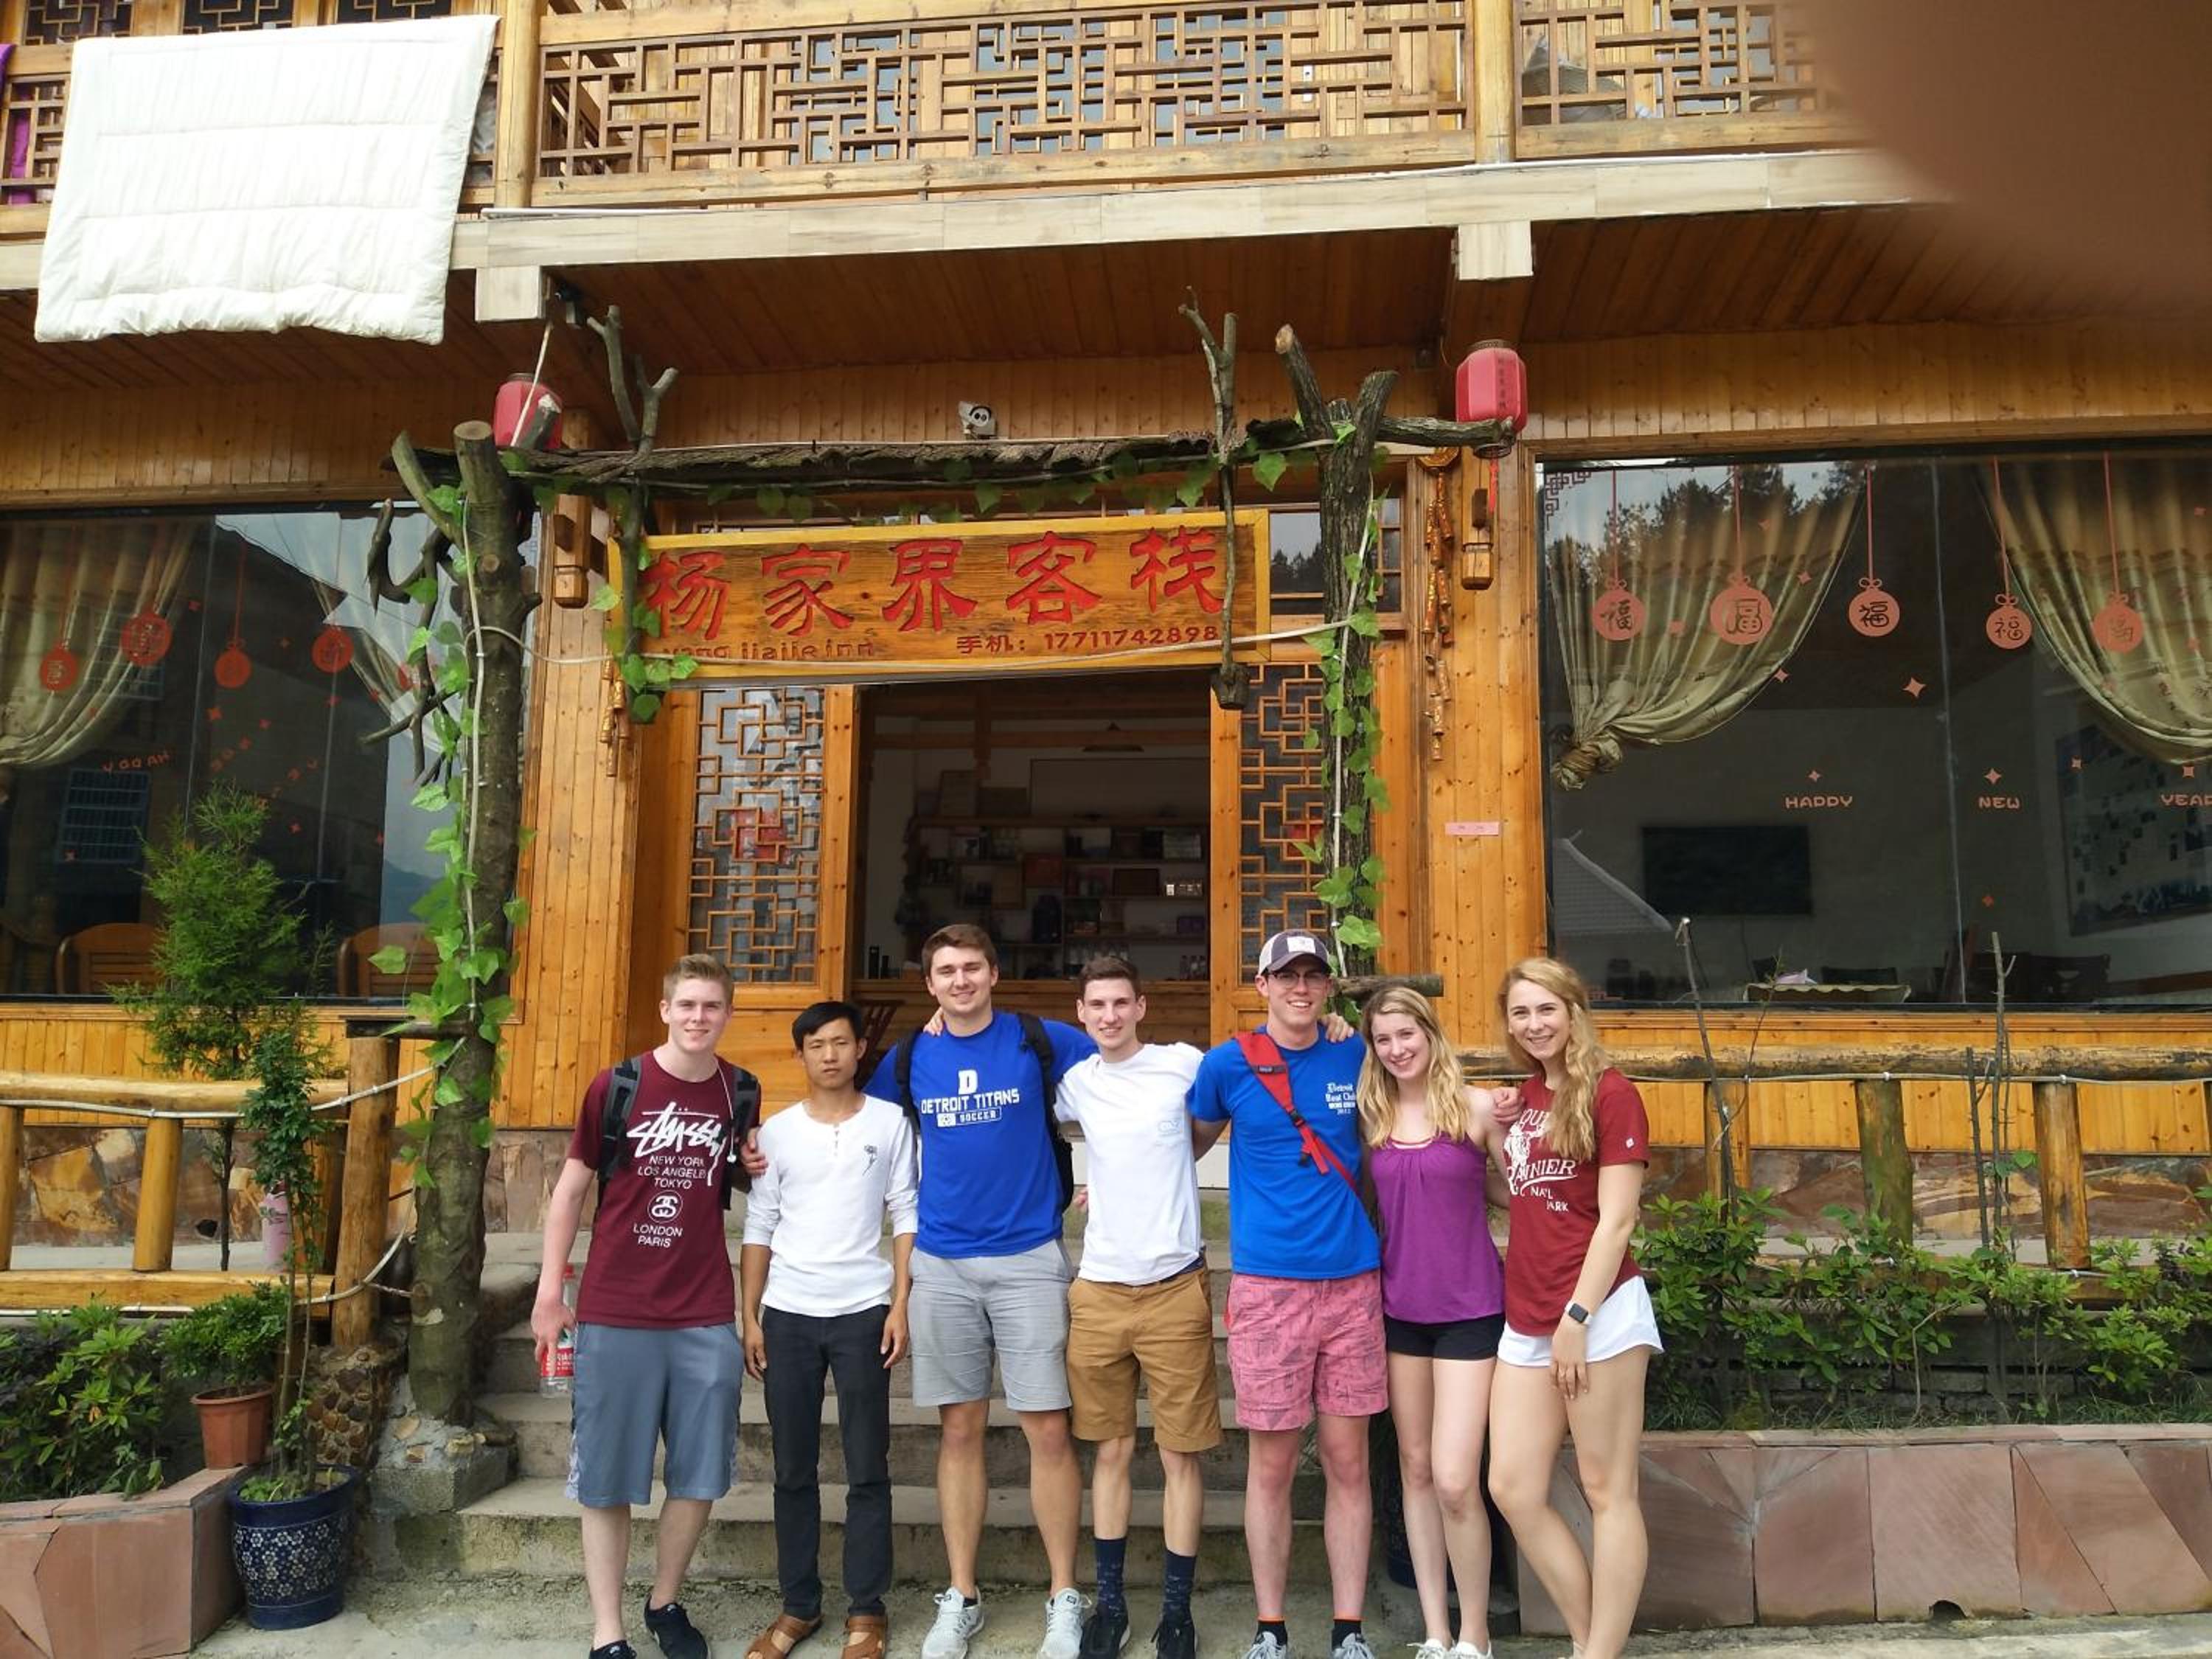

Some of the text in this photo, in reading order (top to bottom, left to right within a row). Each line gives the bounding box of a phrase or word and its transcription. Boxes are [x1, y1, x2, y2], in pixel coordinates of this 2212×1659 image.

[641, 525, 1224, 641] 杨家界客栈
[1859, 600, 1890, 627] 福
[1044, 626, 1218, 650] 17711742898
[1978, 796, 2020, 809] NEW
[958, 1069, 978, 1095] D
[921, 1088, 1020, 1115] DETROIT TITANS
[959, 1110, 996, 1123] SOCCER
[649, 1155, 675, 1165] NEW
[638, 1166, 660, 1176] LOS
[654, 1178, 692, 1189] TOKYO
[633, 1222, 684, 1237] LONDON
[638, 1236, 672, 1248] PARIS
